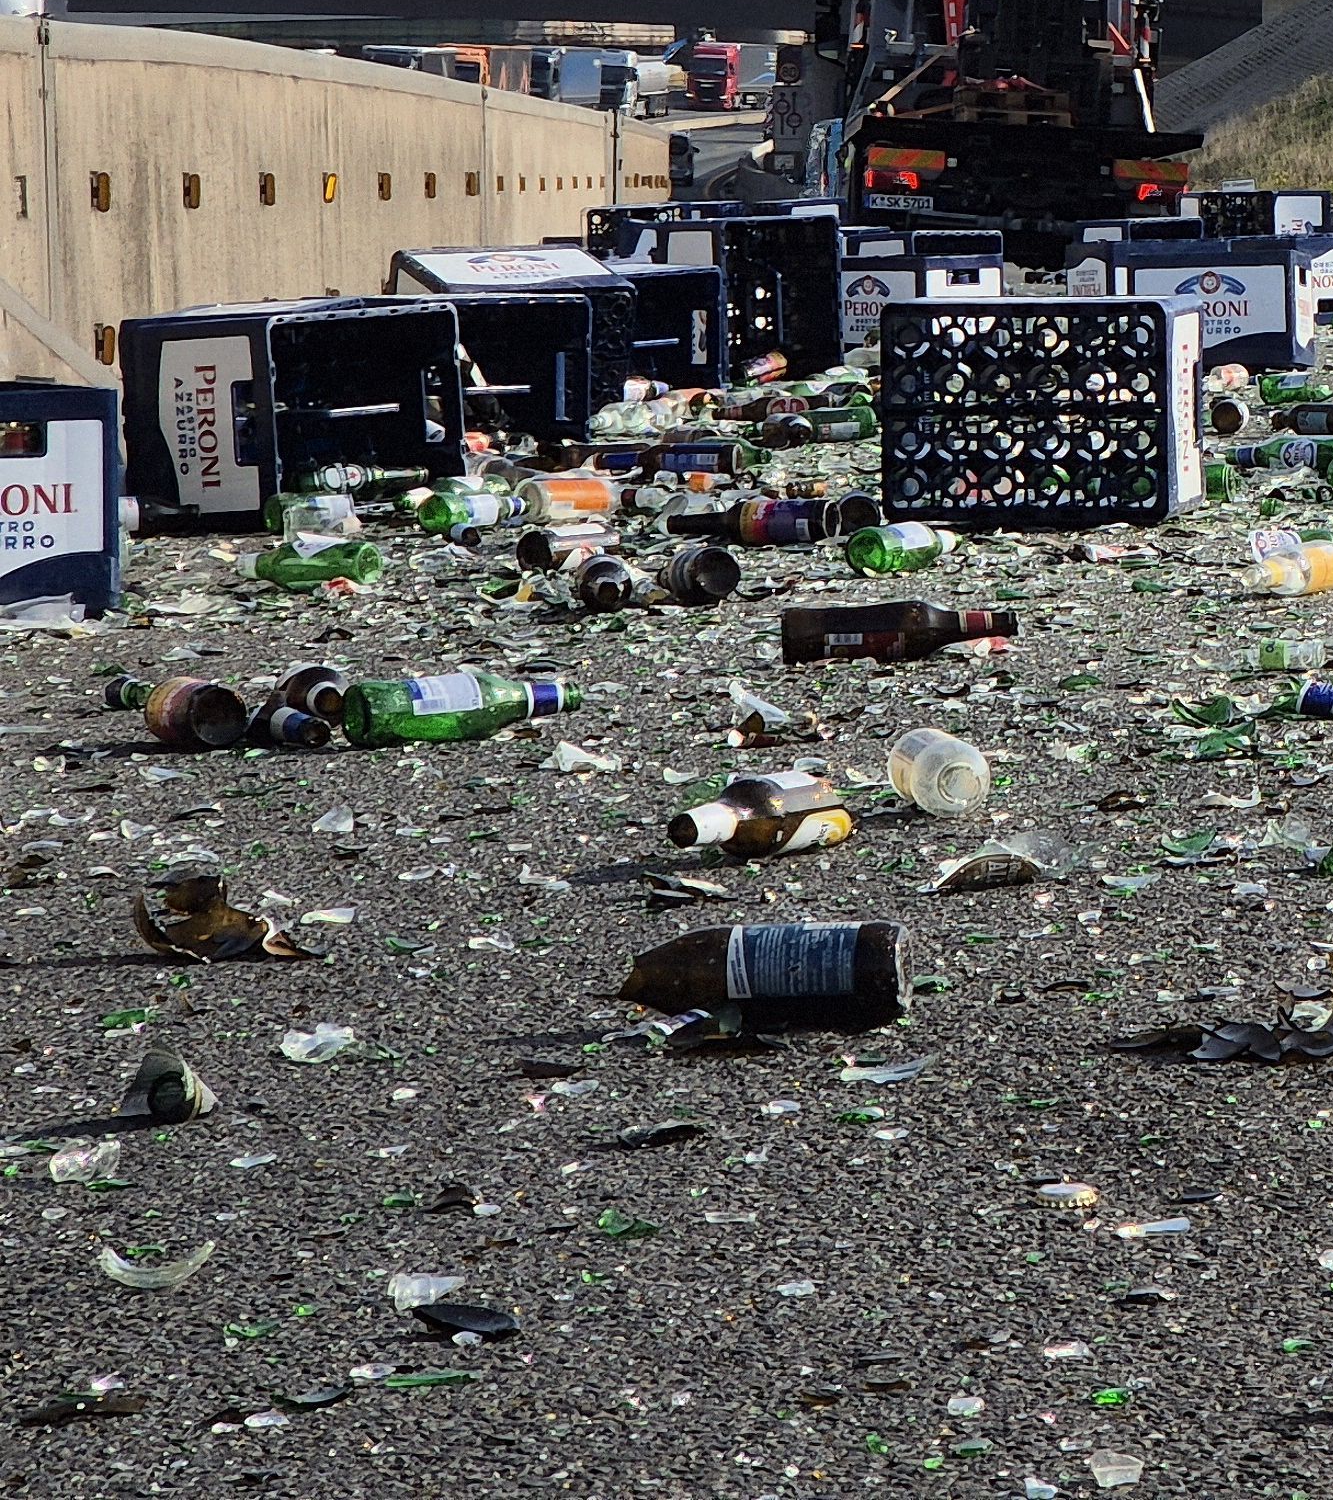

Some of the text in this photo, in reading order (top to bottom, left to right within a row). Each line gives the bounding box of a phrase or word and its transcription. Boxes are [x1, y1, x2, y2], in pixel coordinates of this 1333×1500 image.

[174, 377, 190, 476] AZZURRO
[194, 365, 221, 488] PERONI
[0, 483, 73, 515] ONI
